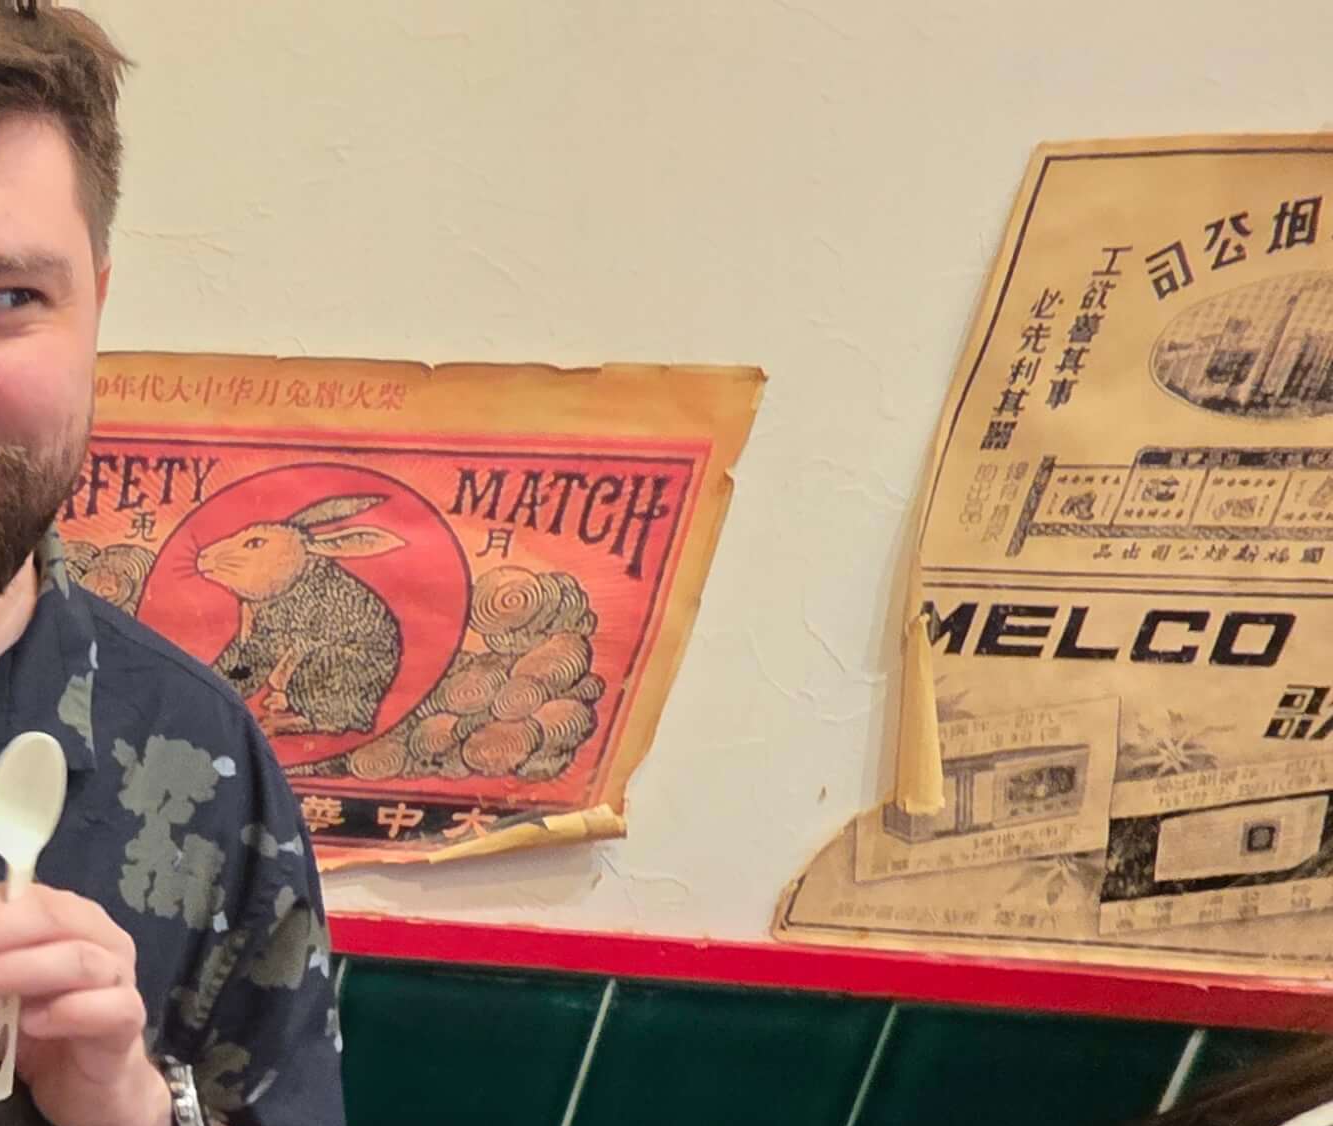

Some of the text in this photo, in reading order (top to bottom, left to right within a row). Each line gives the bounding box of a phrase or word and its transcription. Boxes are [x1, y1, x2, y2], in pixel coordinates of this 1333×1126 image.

[62, 453, 670, 582] FETY MATCH
[921, 600, 1296, 668] MELCO
